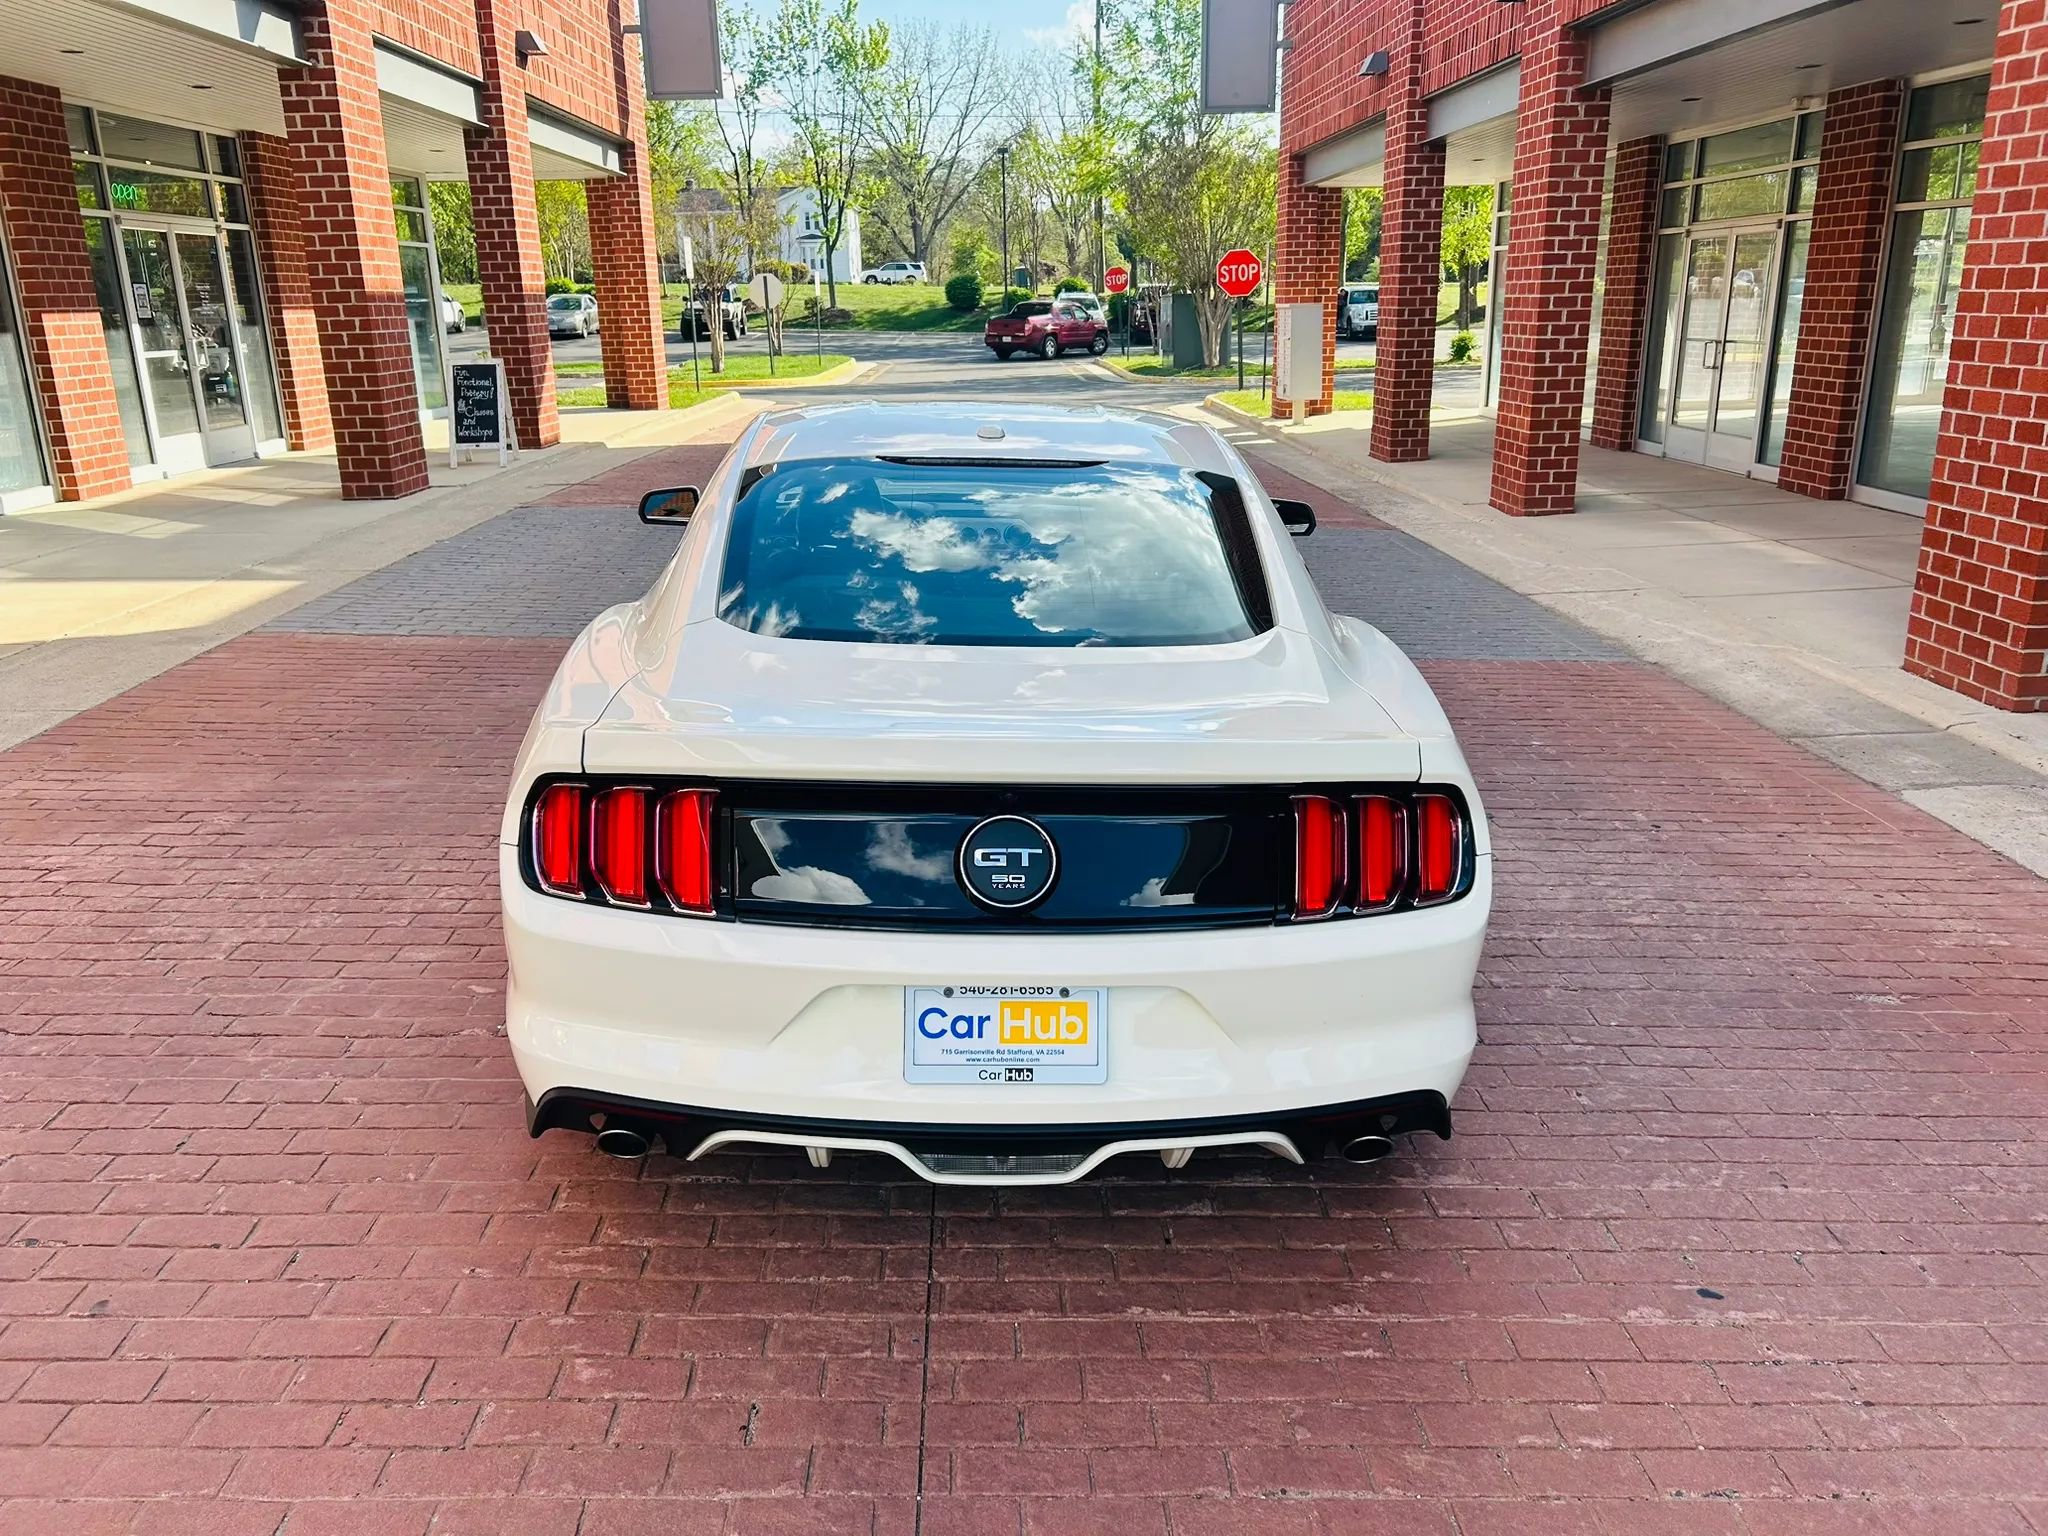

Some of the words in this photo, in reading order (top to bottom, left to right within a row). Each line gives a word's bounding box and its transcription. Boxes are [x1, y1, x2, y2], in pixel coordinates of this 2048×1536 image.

[111, 183, 138, 203] open
[1105, 274, 1128, 286] STOP
[1220, 263, 1259, 283] STOP
[462, 416, 476, 426] and
[457, 425, 493, 441] Workshops
[973, 847, 1043, 867] GT
[991, 874, 1026, 883] 50
[918, 1007, 991, 1039] Car
[1003, 1006, 1084, 1040] Hub
[978, 1069, 1002, 1081] Car
[1005, 1069, 1033, 1081] Hub
